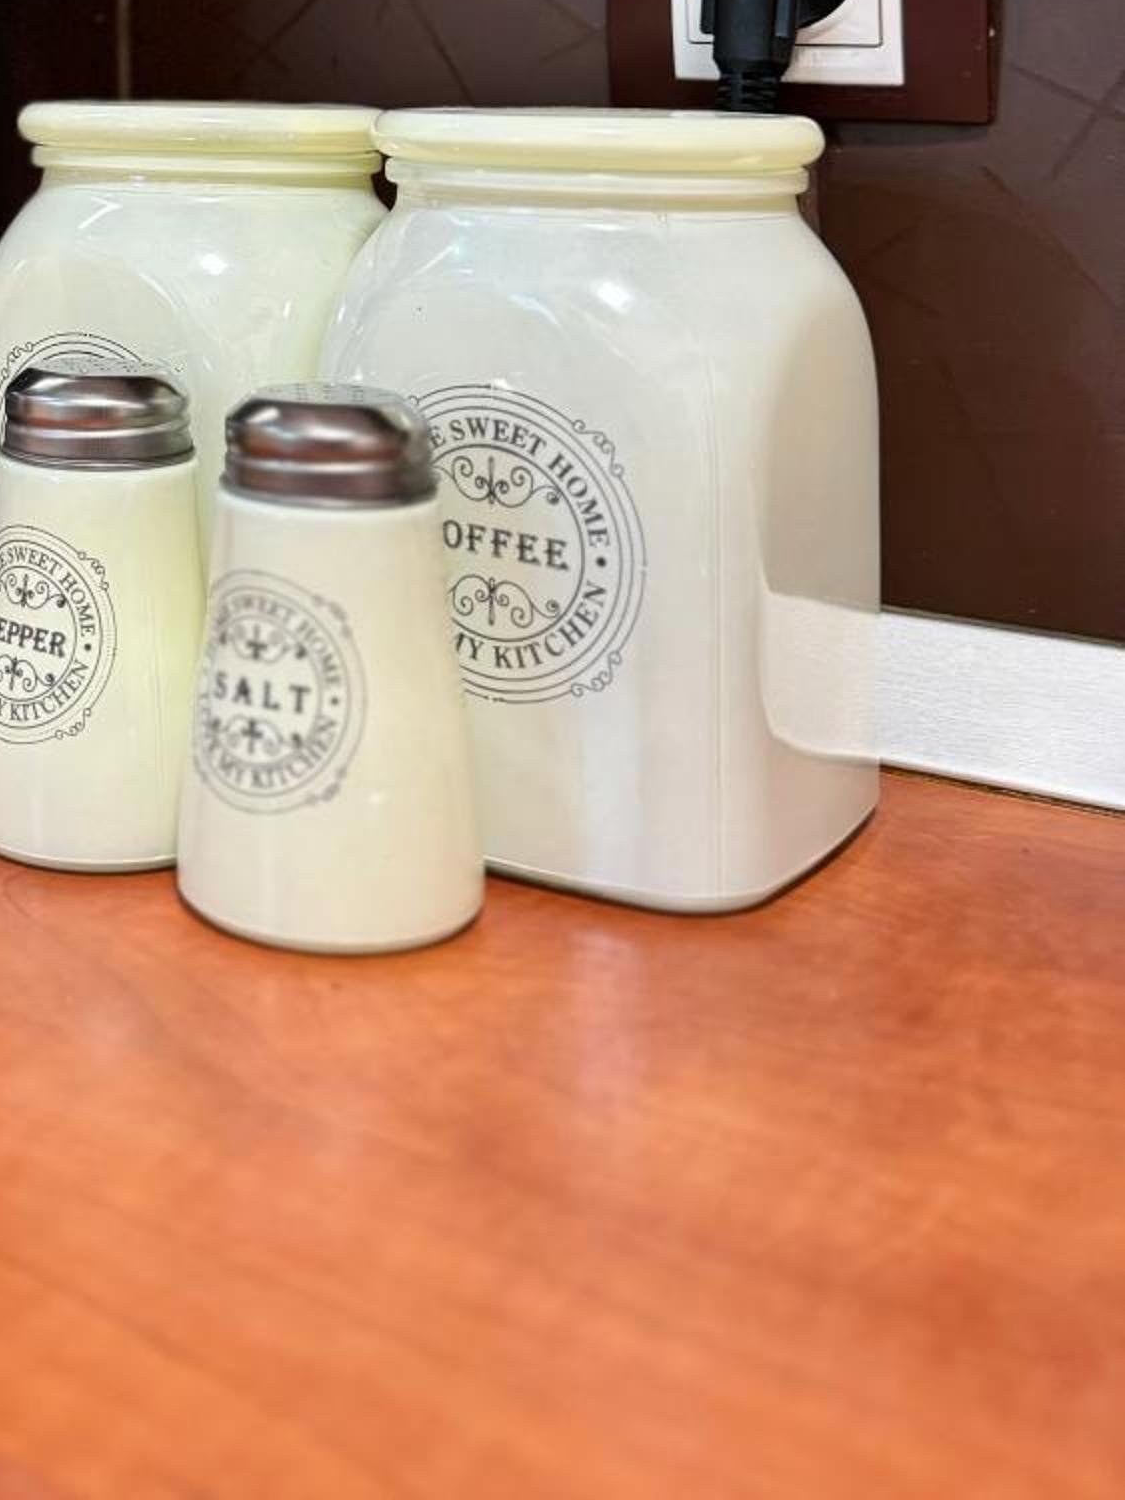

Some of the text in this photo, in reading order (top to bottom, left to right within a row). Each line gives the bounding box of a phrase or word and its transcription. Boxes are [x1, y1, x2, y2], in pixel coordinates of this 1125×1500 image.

[448, 417, 610, 548] SWEET HOME
[442, 519, 570, 571] OFFEE
[6, 545, 62, 576] SWEET
[59, 572, 95, 637] HOME
[493, 580, 606, 669] KITCHEN
[10, 659, 89, 721] KITCHEN
[213, 671, 311, 714] SALT
